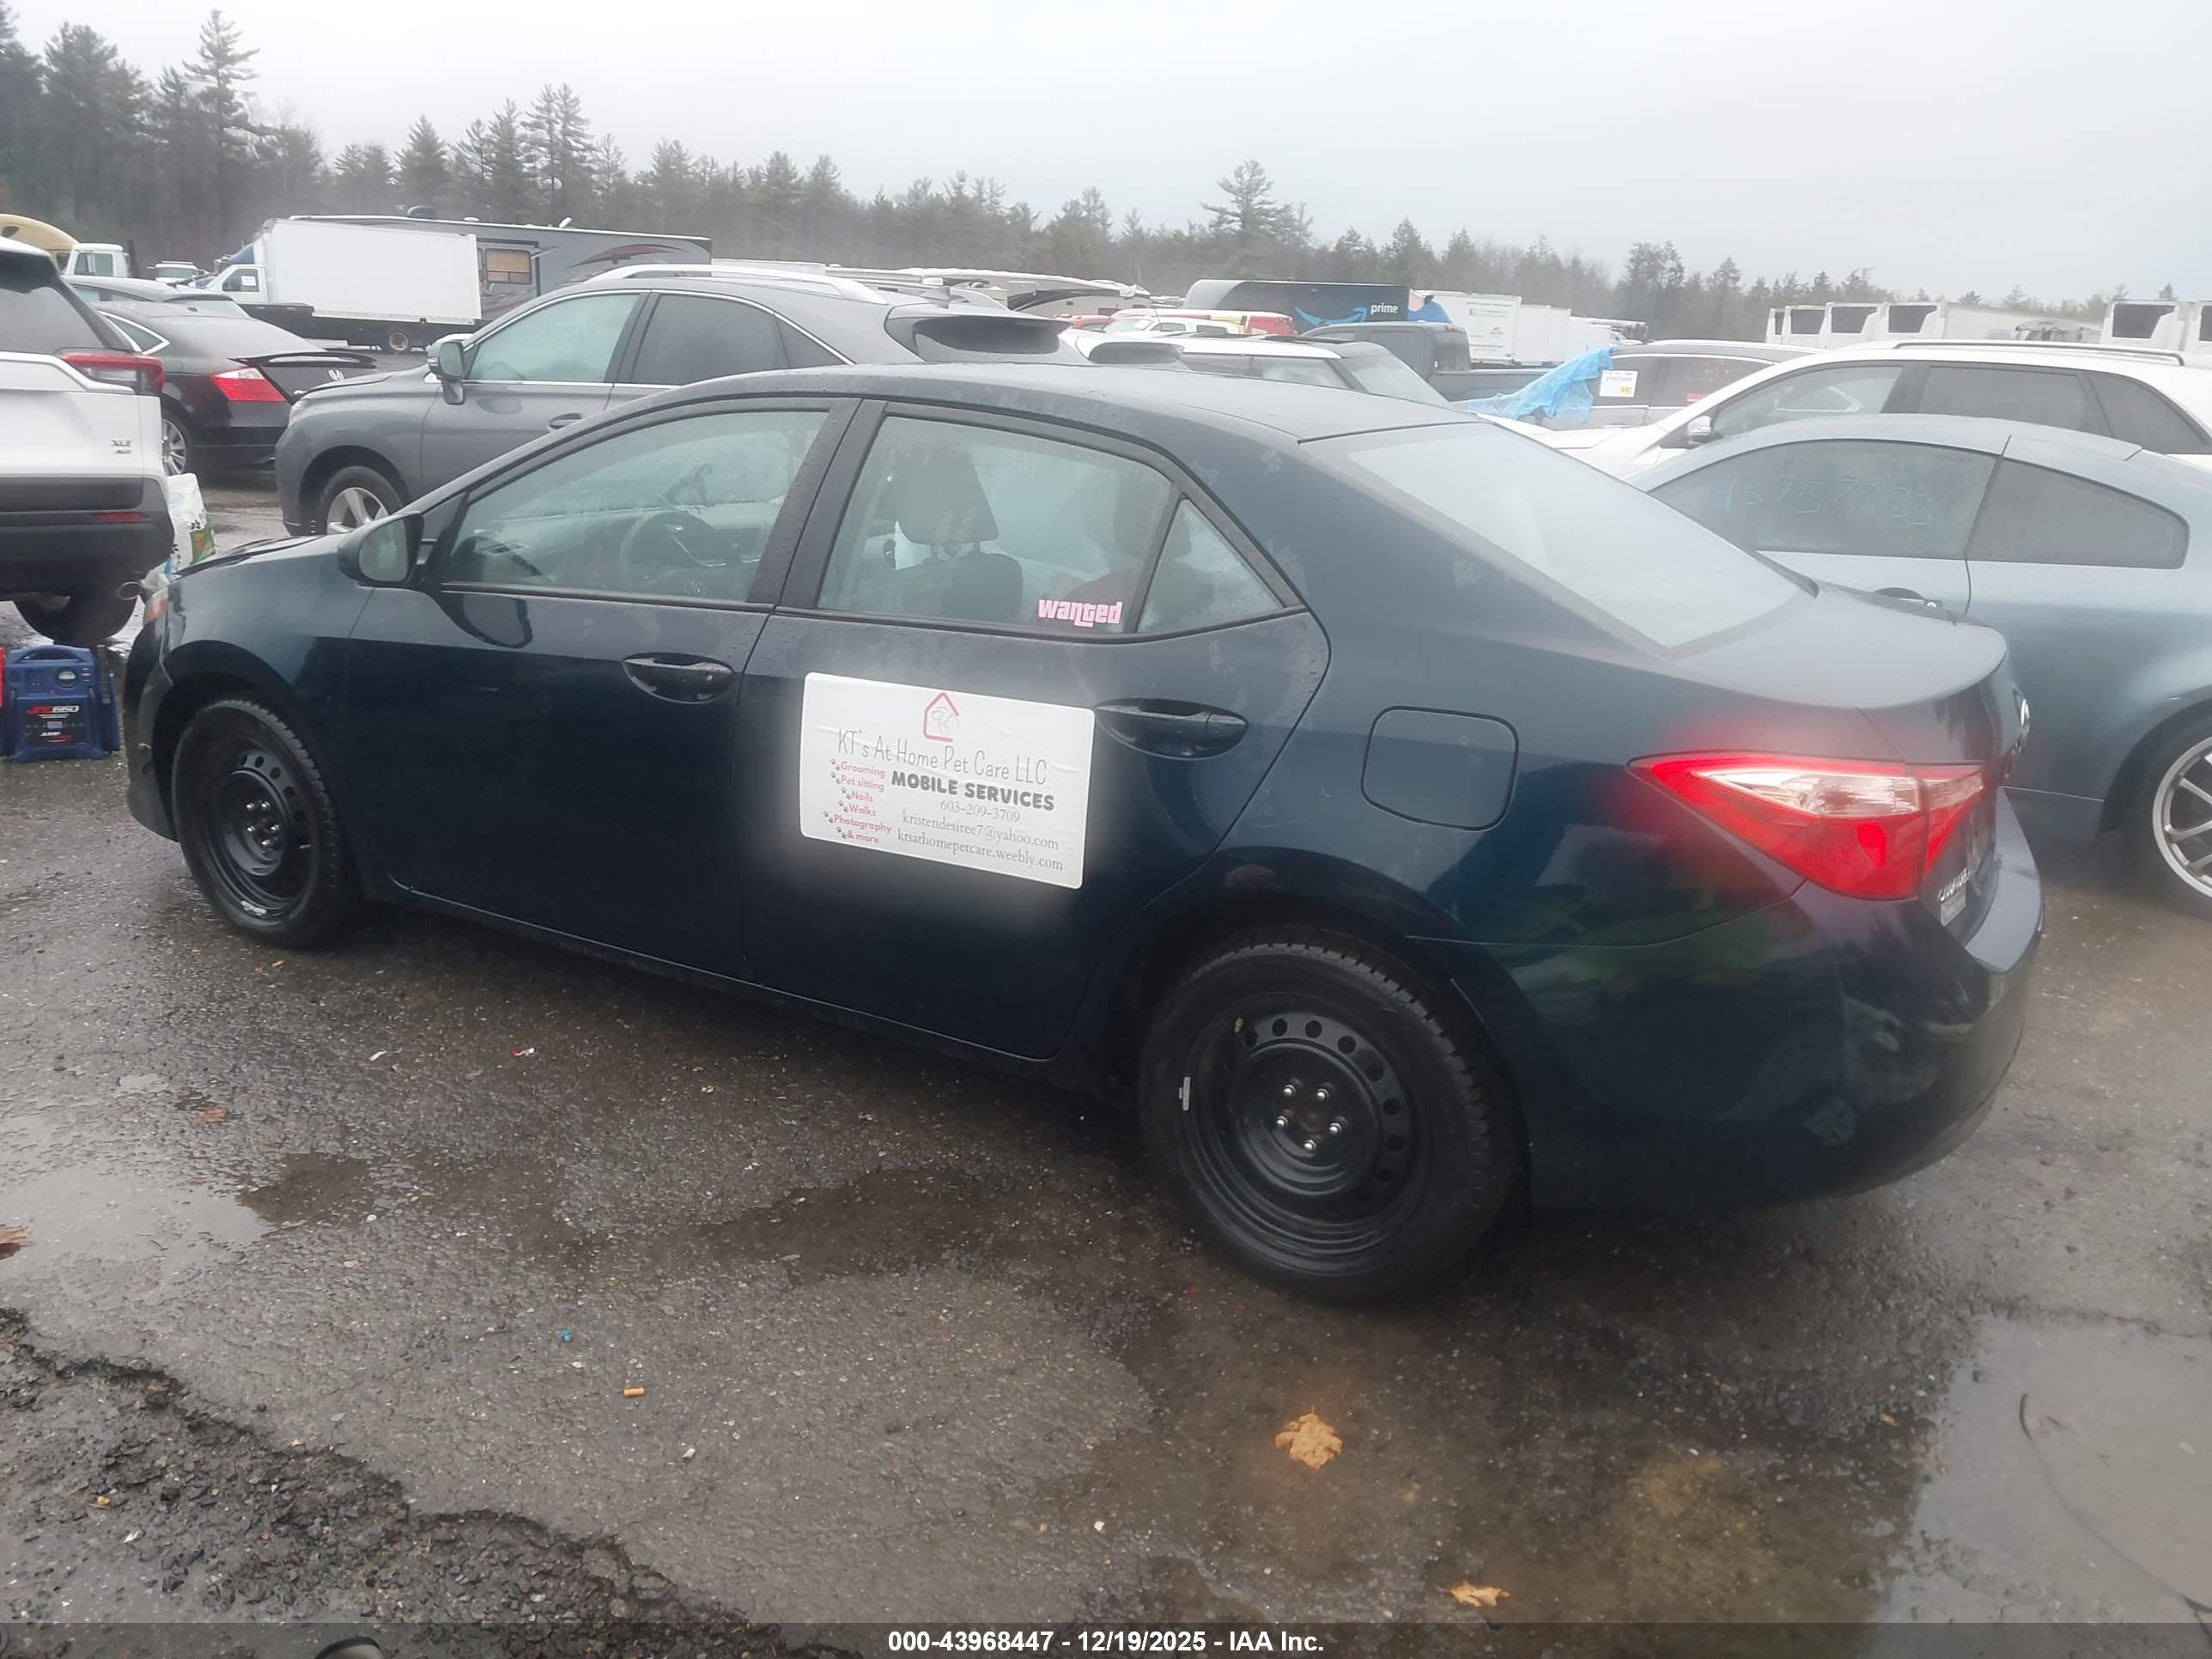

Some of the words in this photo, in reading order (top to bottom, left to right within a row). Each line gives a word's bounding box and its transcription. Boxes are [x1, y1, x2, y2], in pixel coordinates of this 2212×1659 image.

[1370, 301, 1399, 315] prime
[1038, 599, 1123, 628] wanted
[838, 729, 869, 757] KT's
[874, 735, 891, 761] At
[897, 738, 938, 769] Home
[945, 745, 969, 773] Pet
[975, 750, 1009, 780] Care
[1016, 756, 1047, 785] LLC
[841, 761, 886, 780] Grooming
[841, 775, 855, 786] Pet
[857, 778, 885, 793] sitting
[891, 770, 958, 795] MOBILE
[964, 782, 1054, 811] SERVICES
[851, 790, 873, 803] Nails
[848, 804, 876, 817] Walks
[940, 800, 1021, 823] 603-209-3709
[834, 814, 892, 835] Photography
[902, 811, 1059, 850] kristendesiree7@yahoo.com
[847, 830, 854, 839] &
[856, 834, 879, 844] more
